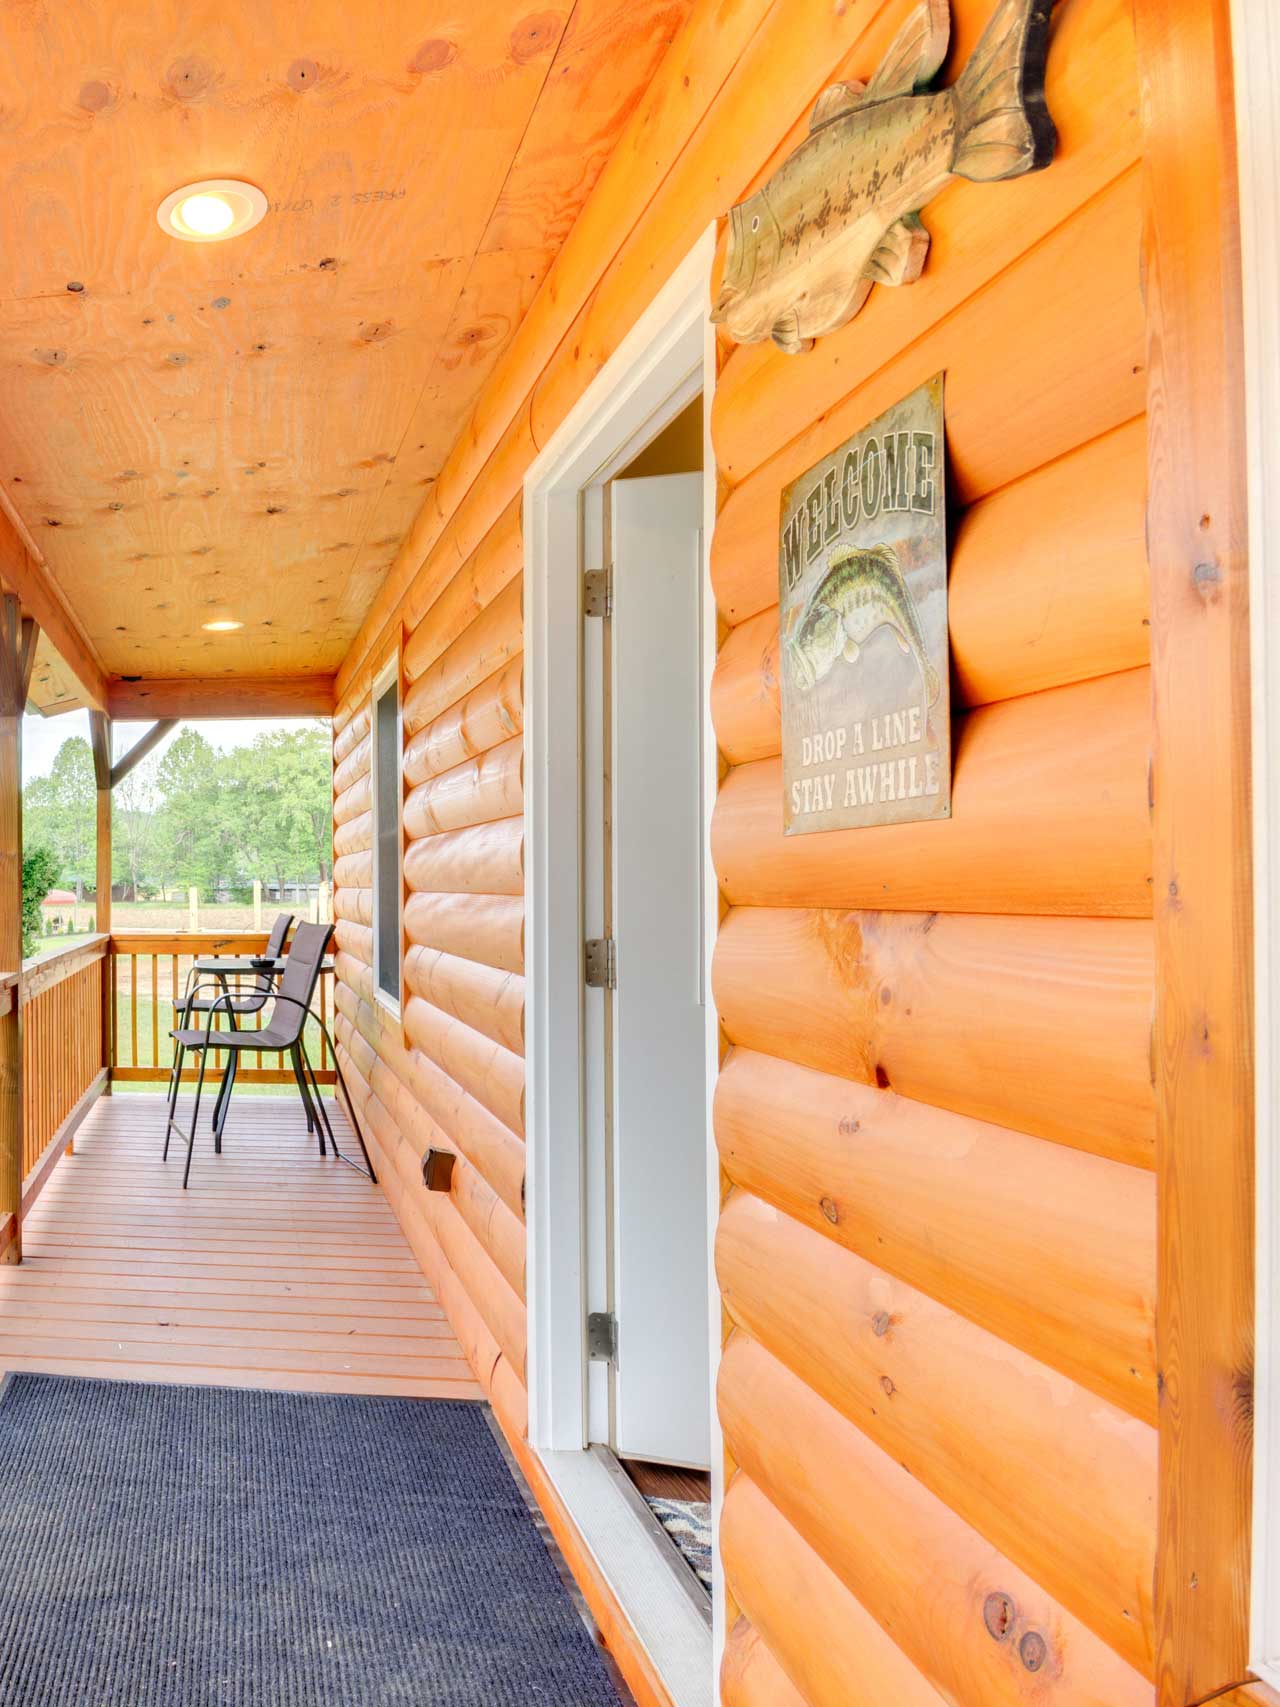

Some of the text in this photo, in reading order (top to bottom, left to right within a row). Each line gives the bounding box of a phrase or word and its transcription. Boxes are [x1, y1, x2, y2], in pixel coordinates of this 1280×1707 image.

[782, 431, 935, 591] WELCOME
[802, 706, 921, 767] DROP A LINE
[791, 753, 939, 816] STAY AWHILE
